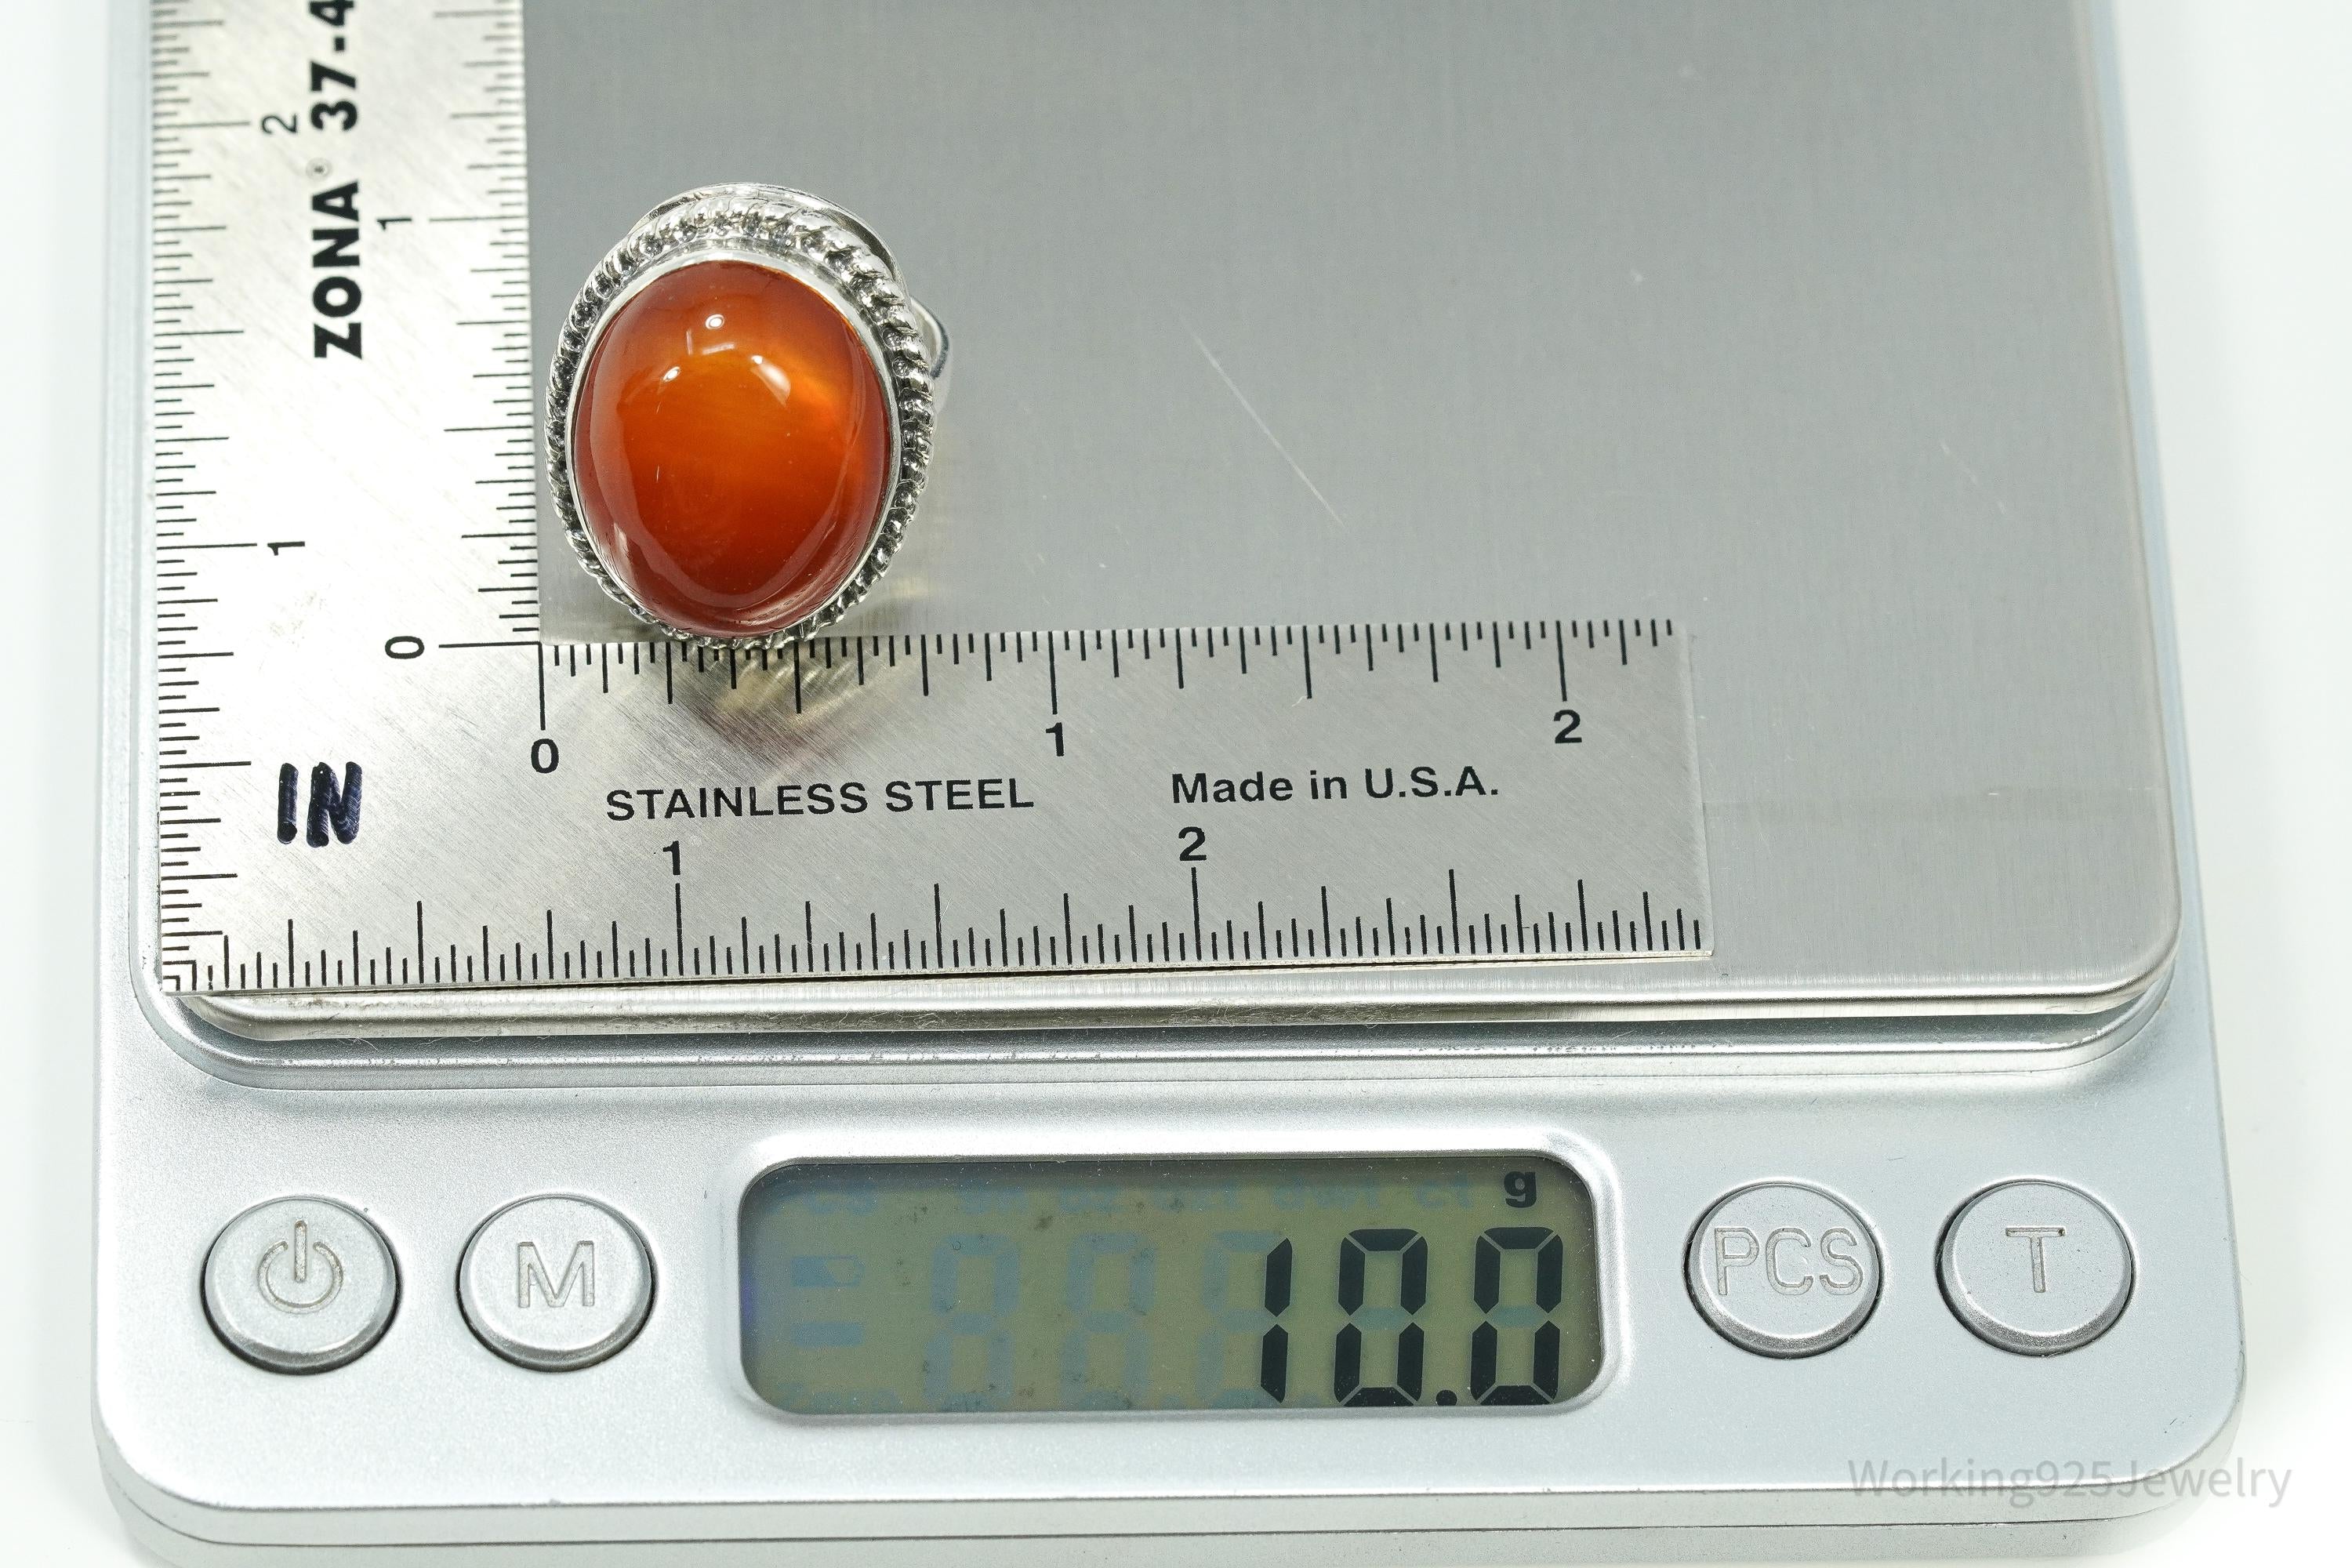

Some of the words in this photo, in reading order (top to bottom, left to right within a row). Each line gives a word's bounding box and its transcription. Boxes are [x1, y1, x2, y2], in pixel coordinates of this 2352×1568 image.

[261, 114, 297, 134] 2
[376, 217, 412, 230] 1
[267, 541, 306, 556] 1
[384, 635, 425, 660] 0
[1045, 722, 1065, 757] 1
[1553, 710, 1582, 744] 2
[531, 738, 560, 774] 0
[607, 782, 868, 822] STAINLESS
[885, 778, 1035, 812] STEEL
[1172, 771, 1294, 804] Made
[1310, 770, 1348, 800] in
[1365, 765, 1499, 799] U.S.A.
[277, 761, 363, 848] IN
[662, 840, 681, 876] 1
[1178, 826, 1207, 862] 2
[1503, 1170, 1538, 1209] g
[516, 1240, 596, 1309] M
[1714, 1226, 1865, 1297] PCS
[2005, 1226, 2067, 1294] T
[1259, 1225, 1564, 1408] 10.0
